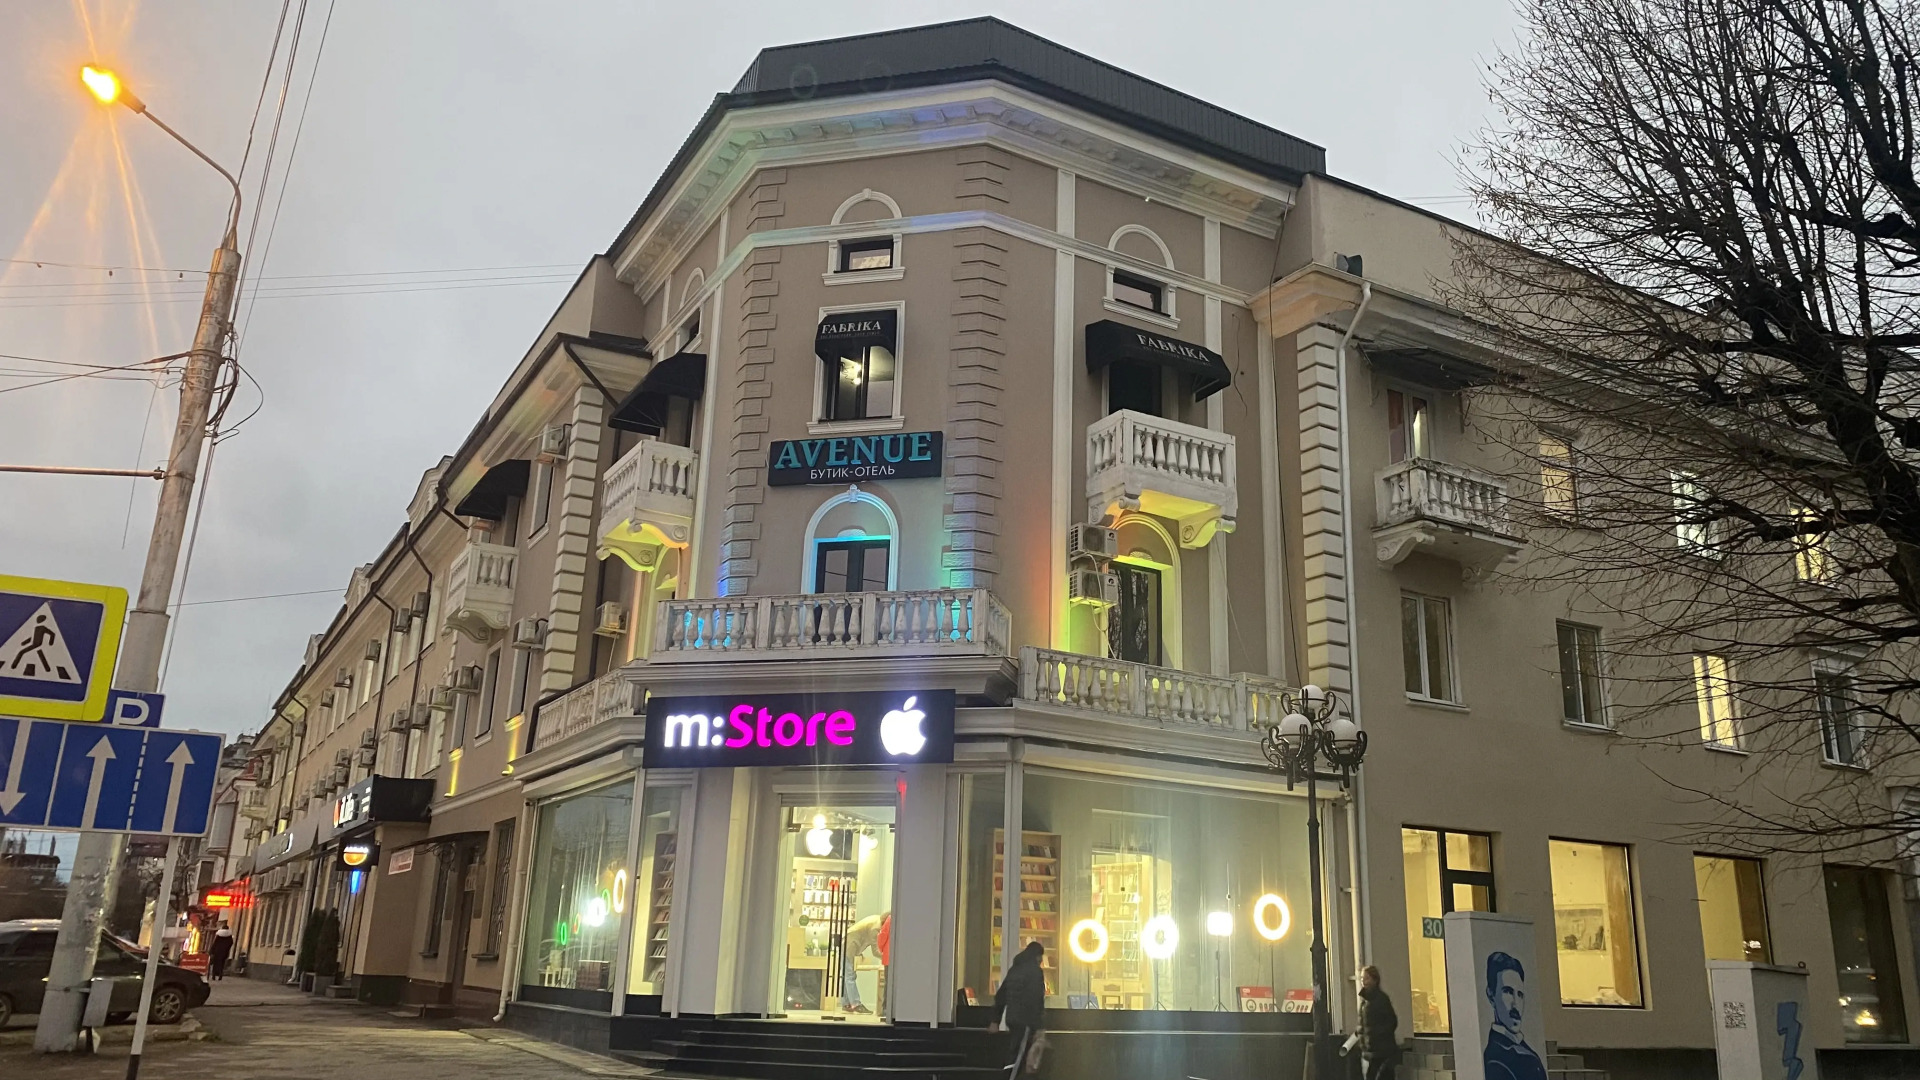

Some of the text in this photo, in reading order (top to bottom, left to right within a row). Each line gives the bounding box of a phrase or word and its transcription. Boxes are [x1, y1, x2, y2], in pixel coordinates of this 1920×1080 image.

[821, 320, 881, 334] FABRIKA
[1136, 333, 1211, 363] FABRIKA
[774, 432, 932, 469] AVENUE
[810, 465, 895, 480] БУТИК-ОТЕЛЬ
[111, 697, 150, 726] P
[663, 704, 857, 748] m:Store
[1423, 918, 1443, 938] 30
